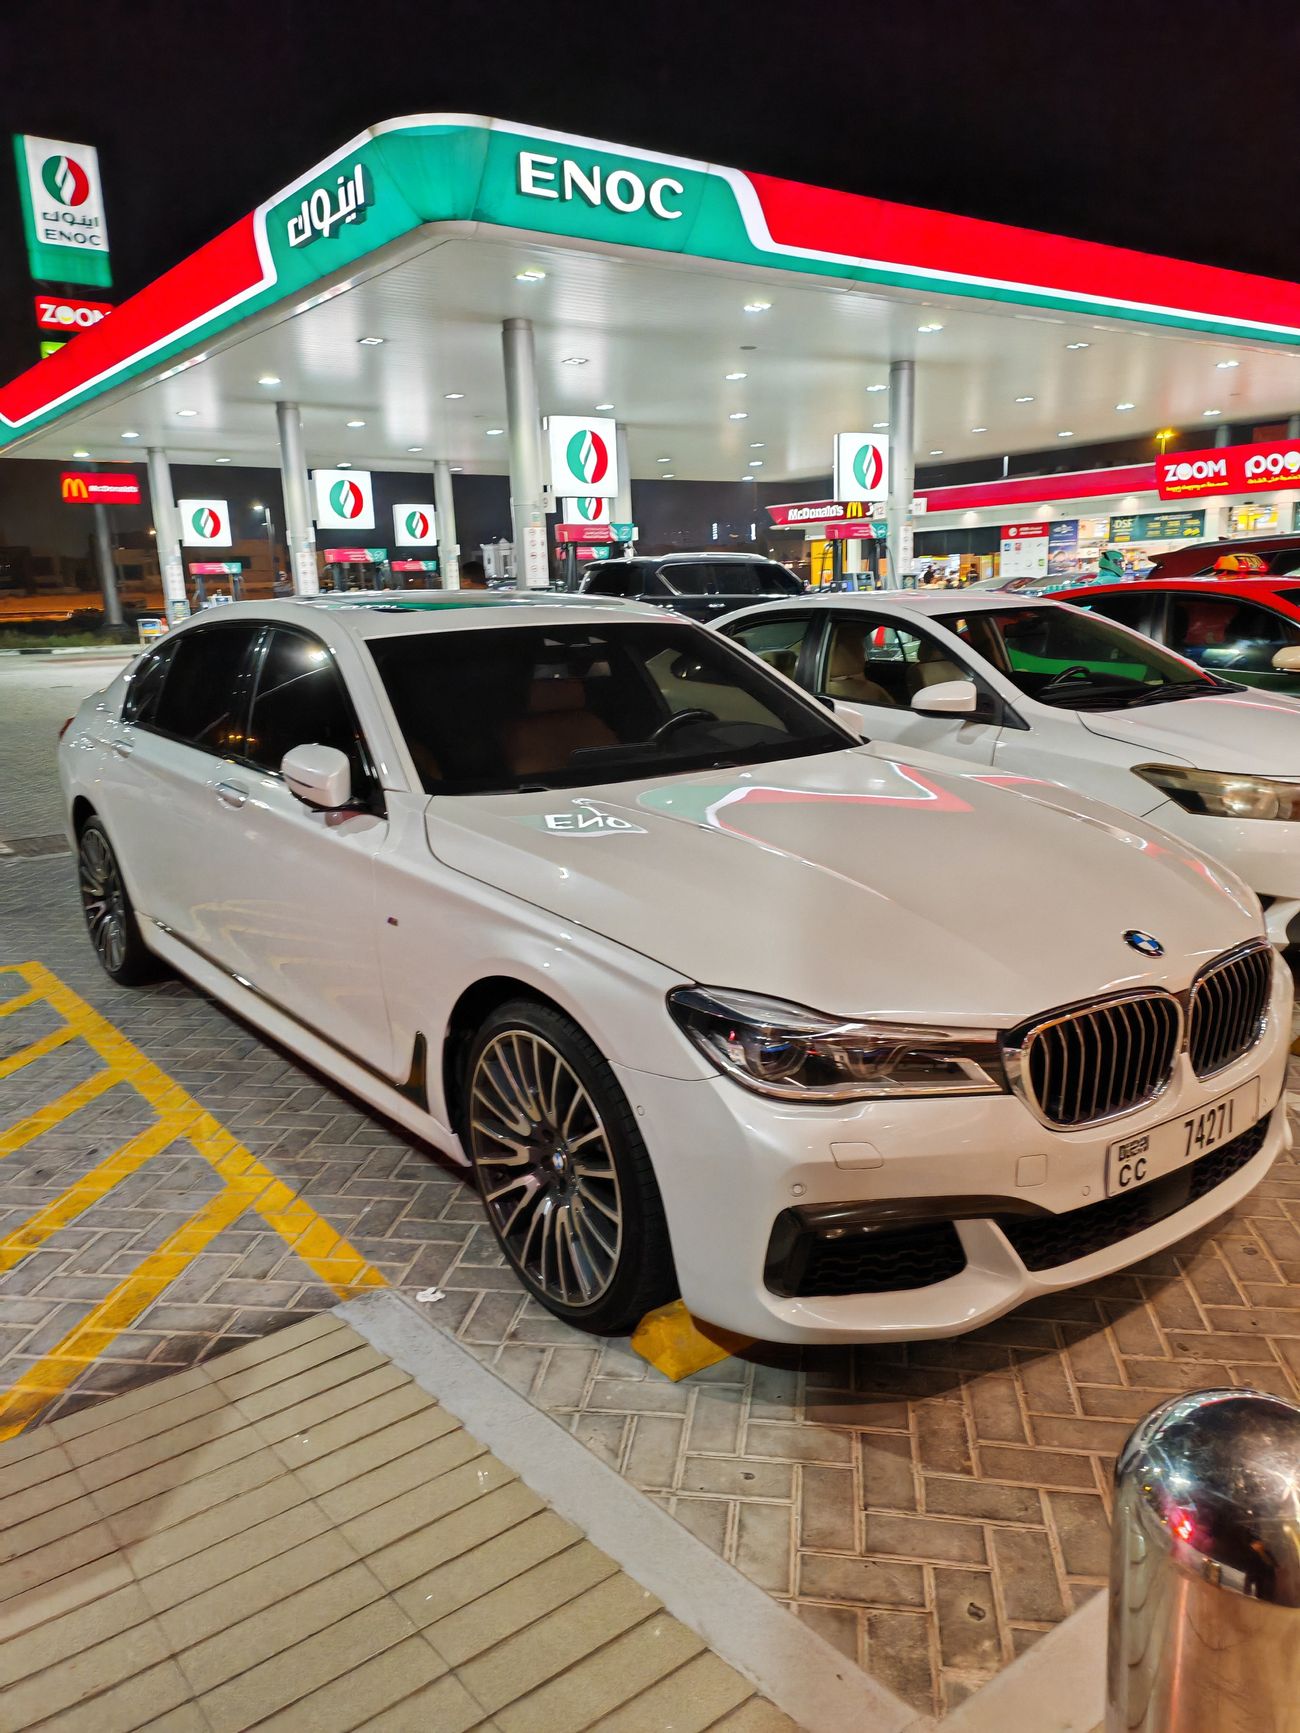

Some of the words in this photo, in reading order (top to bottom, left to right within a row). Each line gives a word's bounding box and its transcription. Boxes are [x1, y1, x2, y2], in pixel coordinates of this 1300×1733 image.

[517, 151, 684, 220] ENOC
[287, 163, 366, 248] اينوك
[45, 228, 102, 245] ENOC
[1163, 459, 1227, 482] ZOOM
[787, 504, 844, 521] McDonald's
[1184, 1098, 1234, 1157] 74271
[1119, 1157, 1147, 1187] CC
